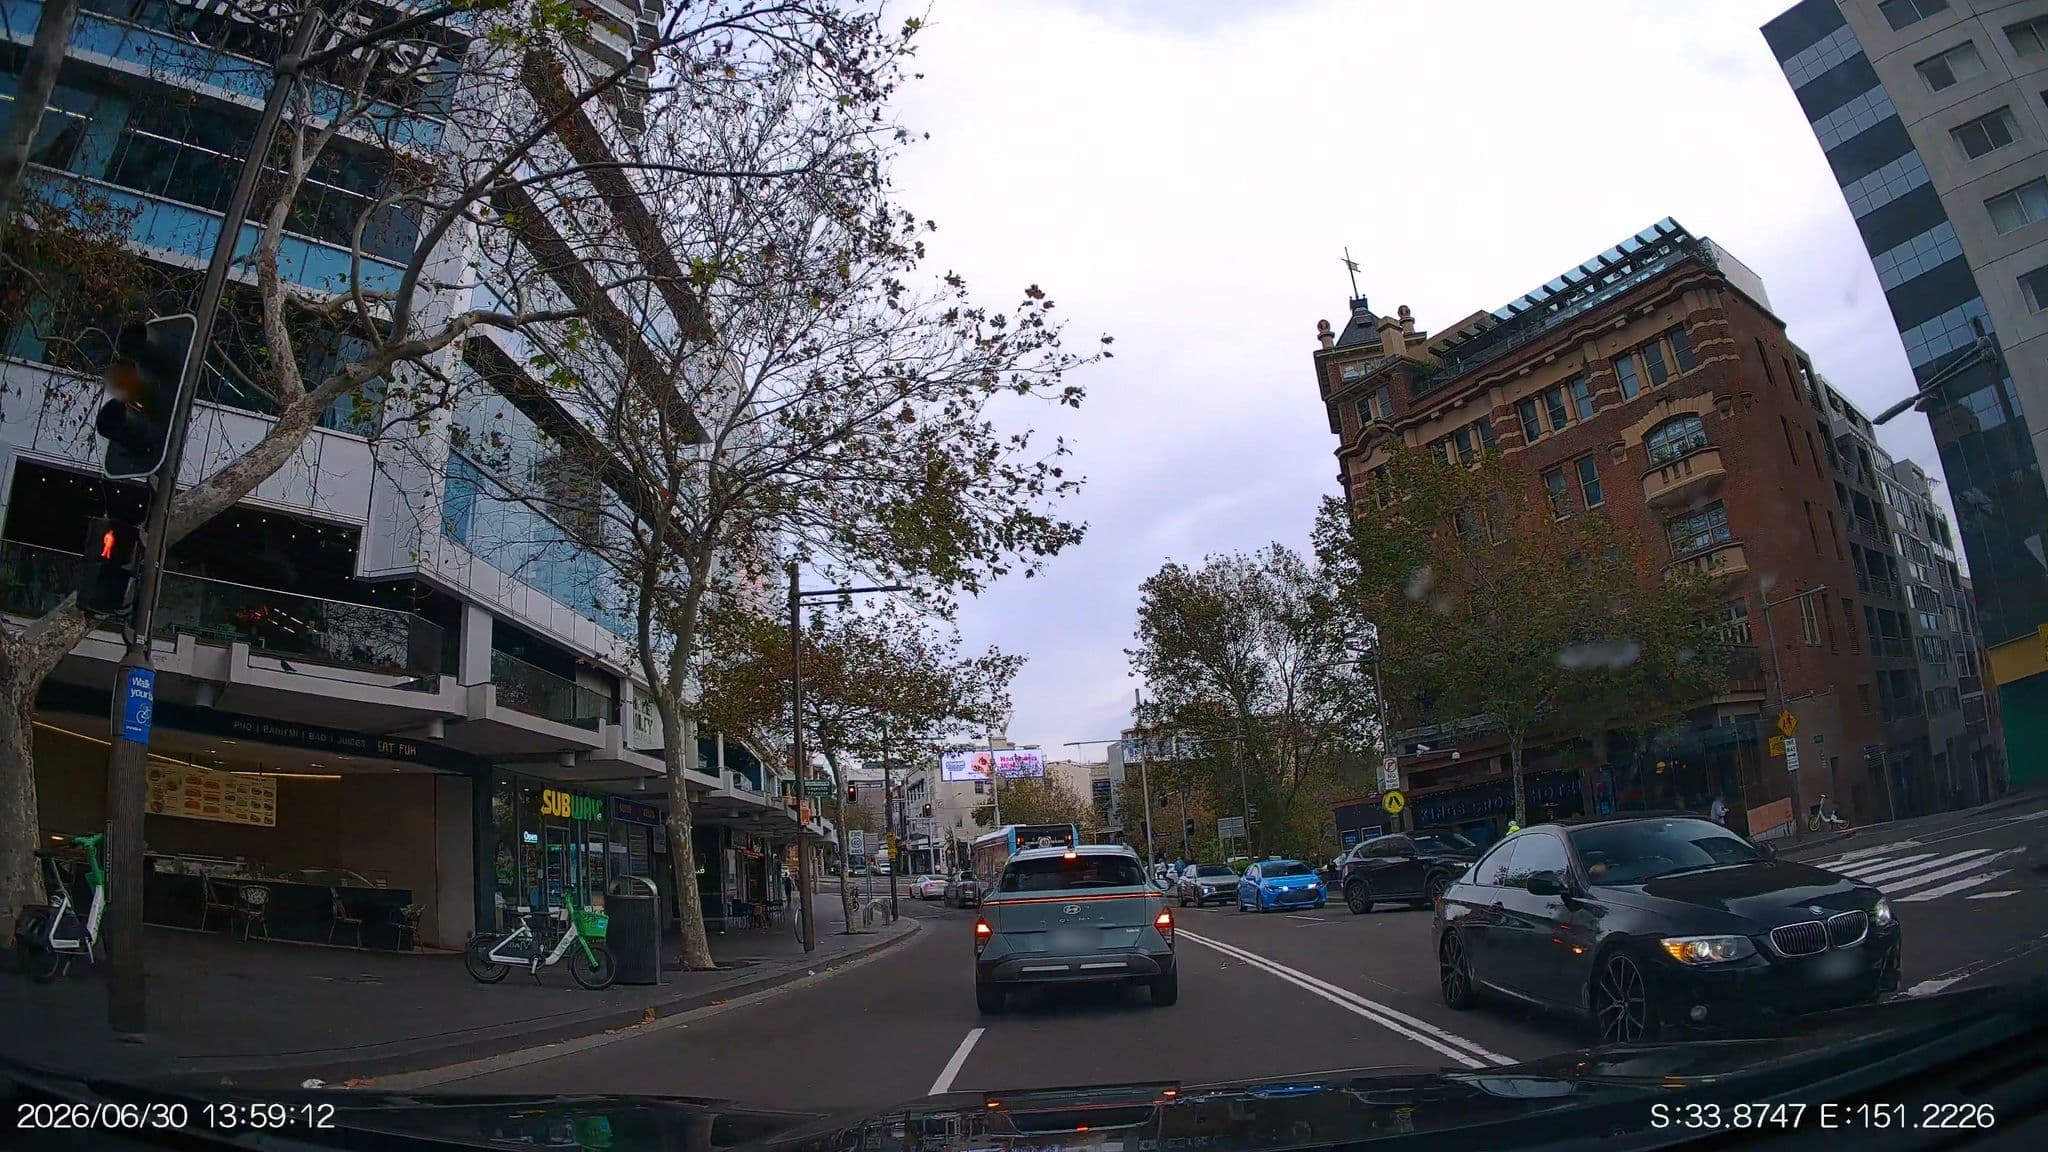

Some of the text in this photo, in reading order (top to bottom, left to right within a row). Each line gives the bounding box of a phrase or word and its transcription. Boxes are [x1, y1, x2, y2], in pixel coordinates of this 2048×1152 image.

[130, 687, 149, 699] your
[337, 735, 366, 748] JUICES
[377, 740, 417, 756] EAT FUH
[541, 789, 602, 822] SUBWAY
[523, 831, 538, 841] Open
